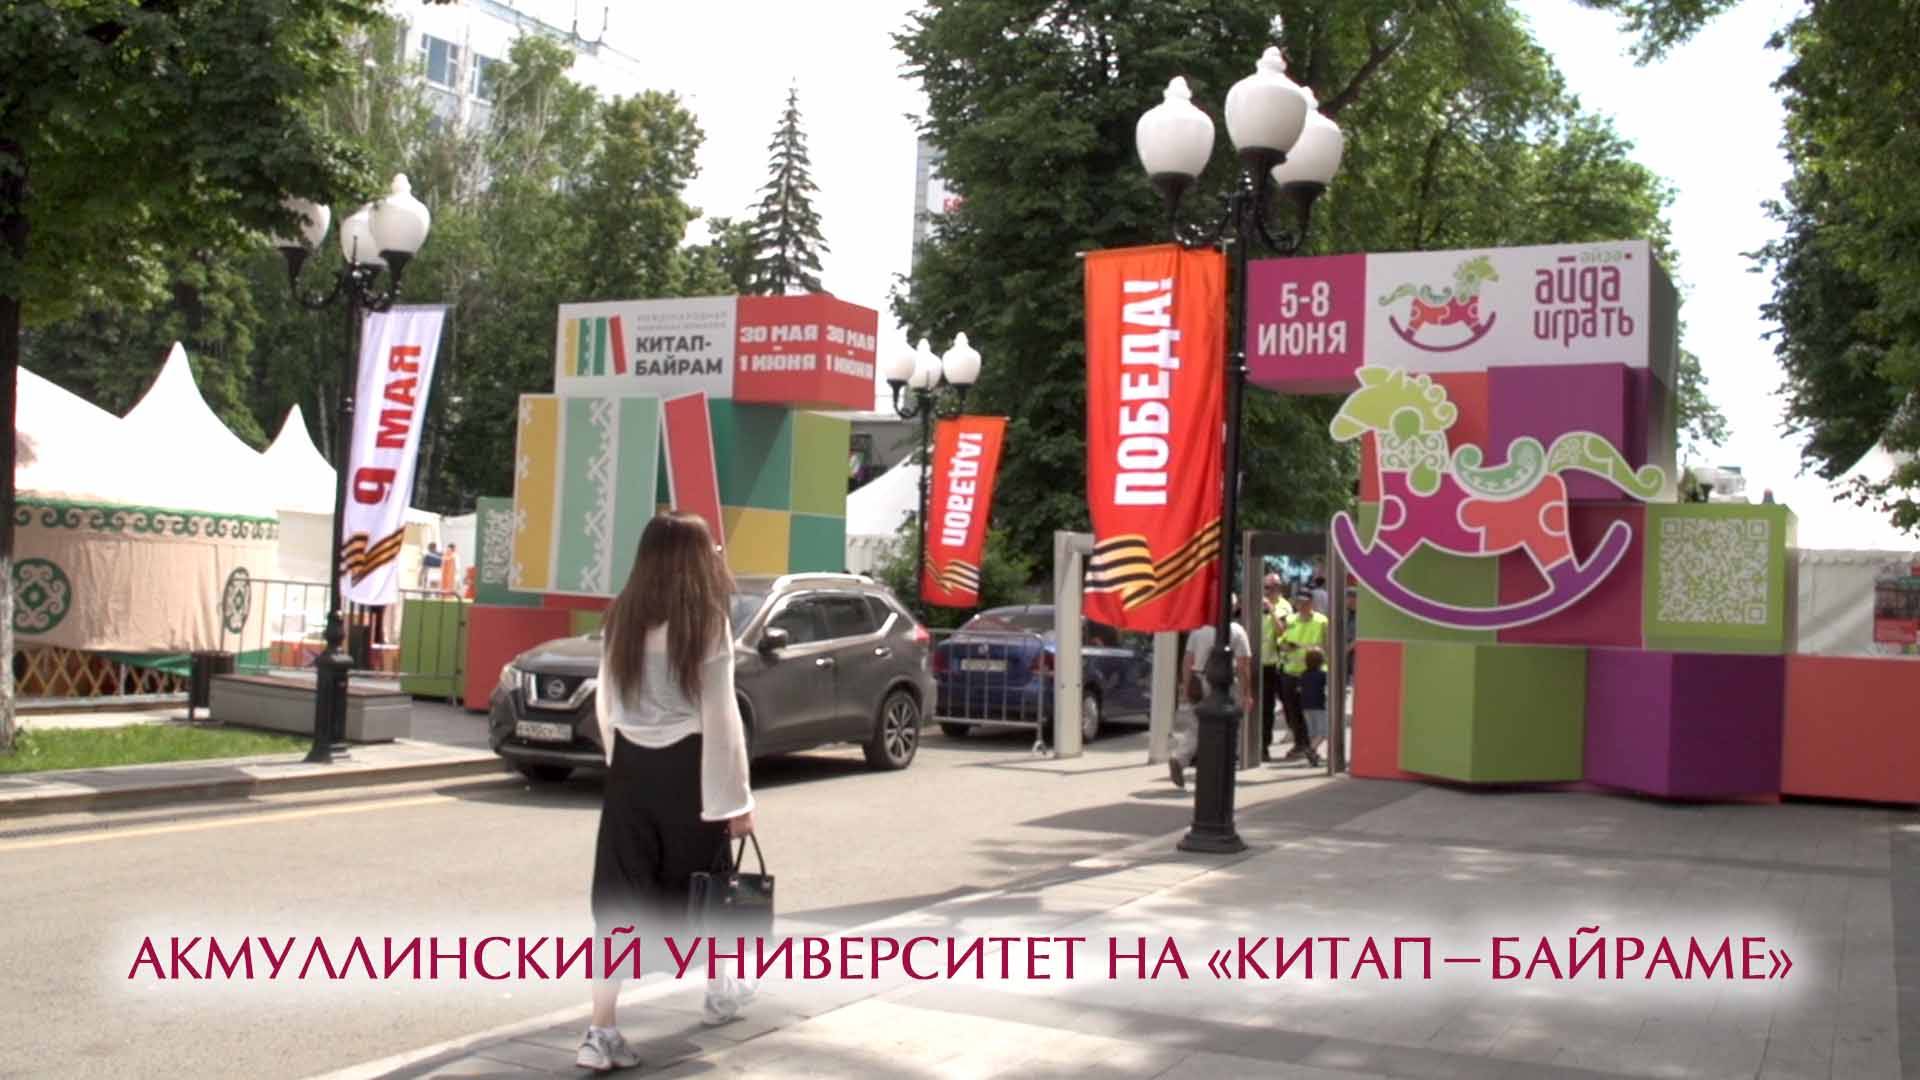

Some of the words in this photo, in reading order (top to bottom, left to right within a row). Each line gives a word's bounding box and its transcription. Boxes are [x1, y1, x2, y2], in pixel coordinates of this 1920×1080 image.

[1281, 281, 1330, 318] 5-8
[1535, 256, 1621, 308] айда
[636, 335, 711, 353] КИТАП-
[740, 325, 767, 343] 30
[771, 324, 819, 343] МАЯ
[1258, 320, 1347, 356] ИЮНЯ
[1534, 307, 1634, 348] играть
[635, 355, 723, 376] БАЙРАМ
[740, 355, 748, 371] 1
[752, 354, 816, 371] ИЮНЯ
[1114, 278, 1180, 505] ПОБЕДА!
[354, 467, 396, 505] 9
[376, 345, 421, 449] МАЯ
